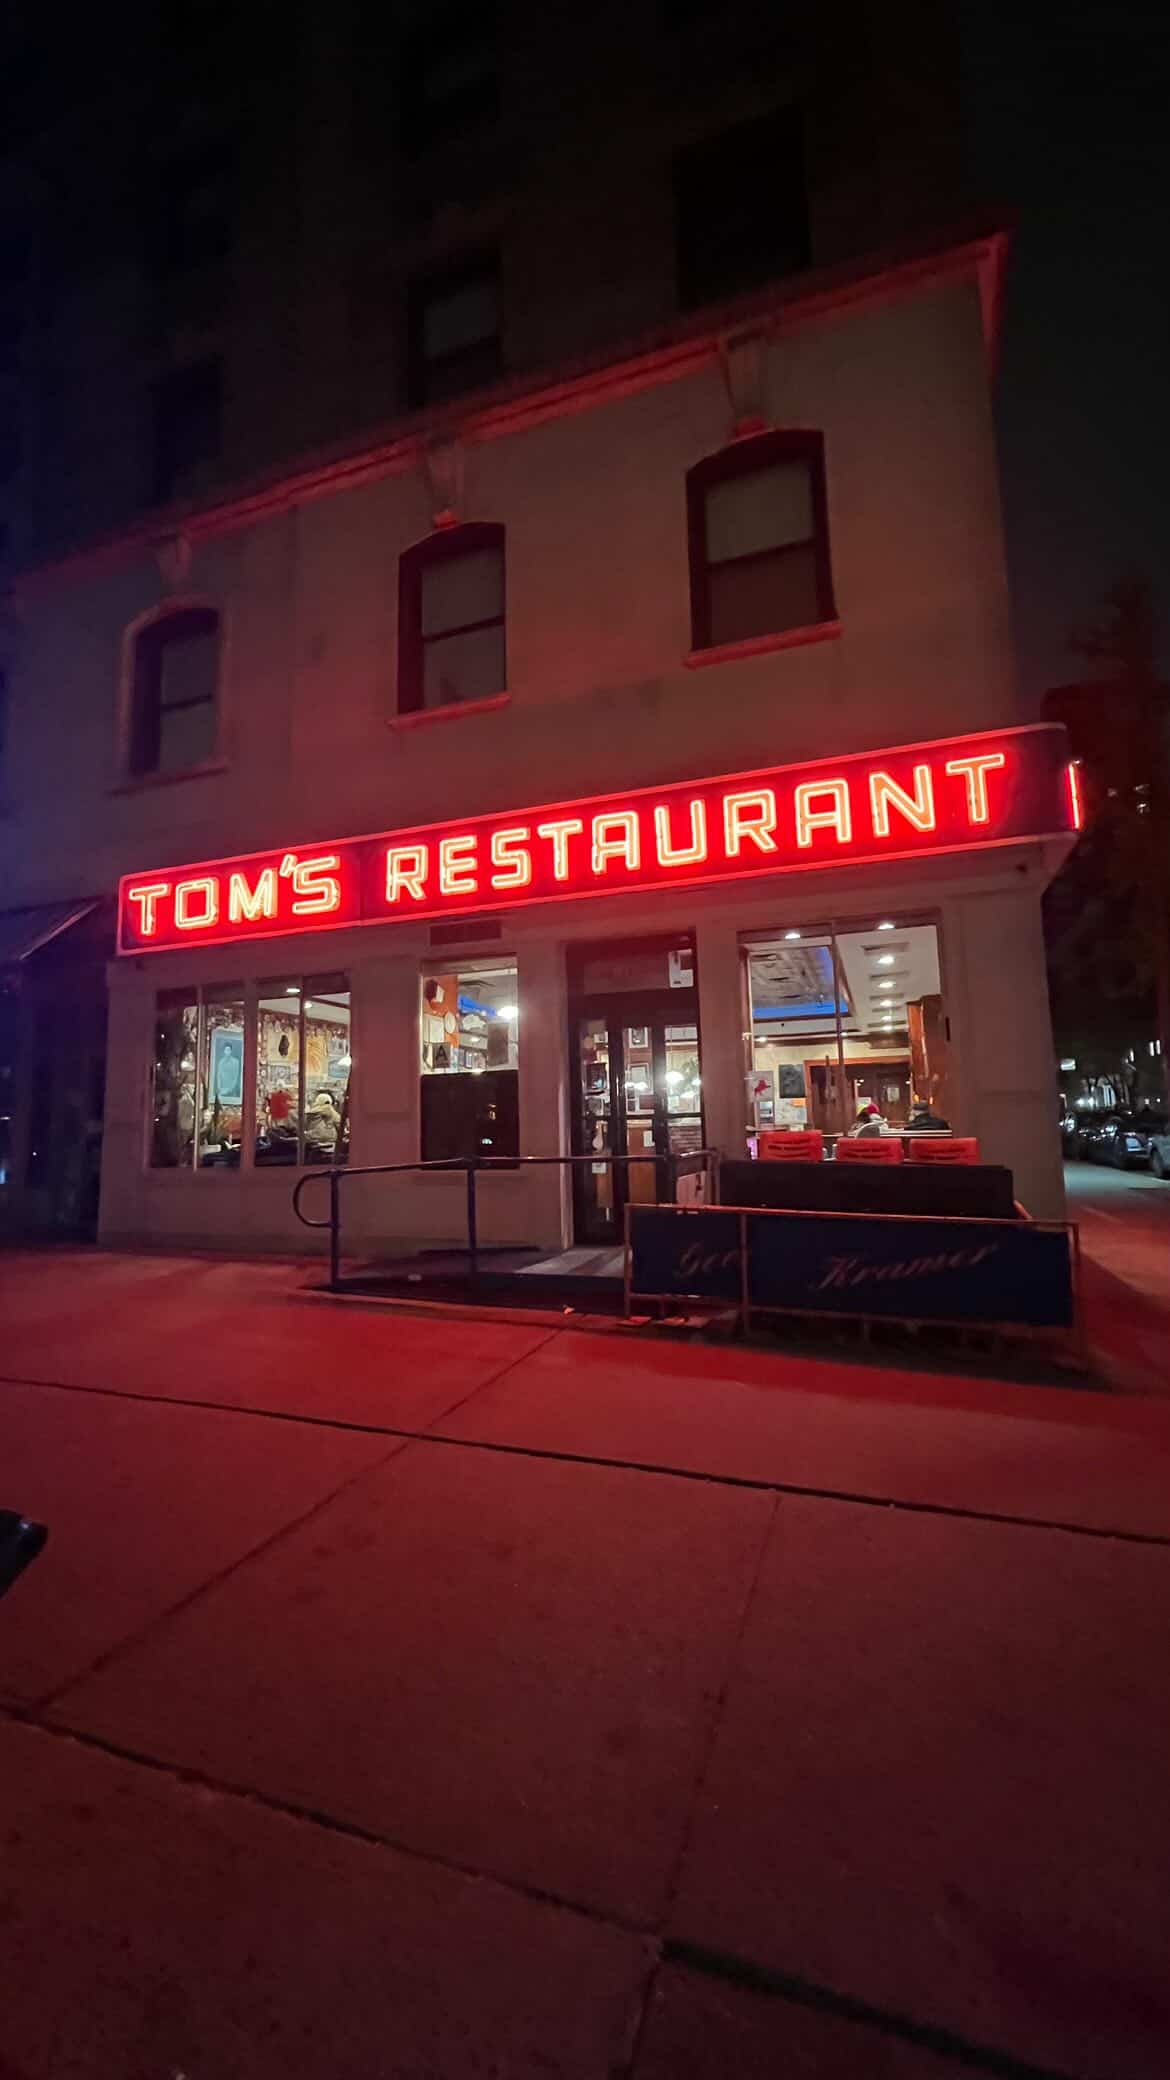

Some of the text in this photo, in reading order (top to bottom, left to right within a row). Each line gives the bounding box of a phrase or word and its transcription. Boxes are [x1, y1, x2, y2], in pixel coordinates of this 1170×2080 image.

[127, 752, 1007, 937] TOM'S RESTAURANT
[435, 1045, 449, 1061] A
[812, 1243, 998, 1291] Kramer
